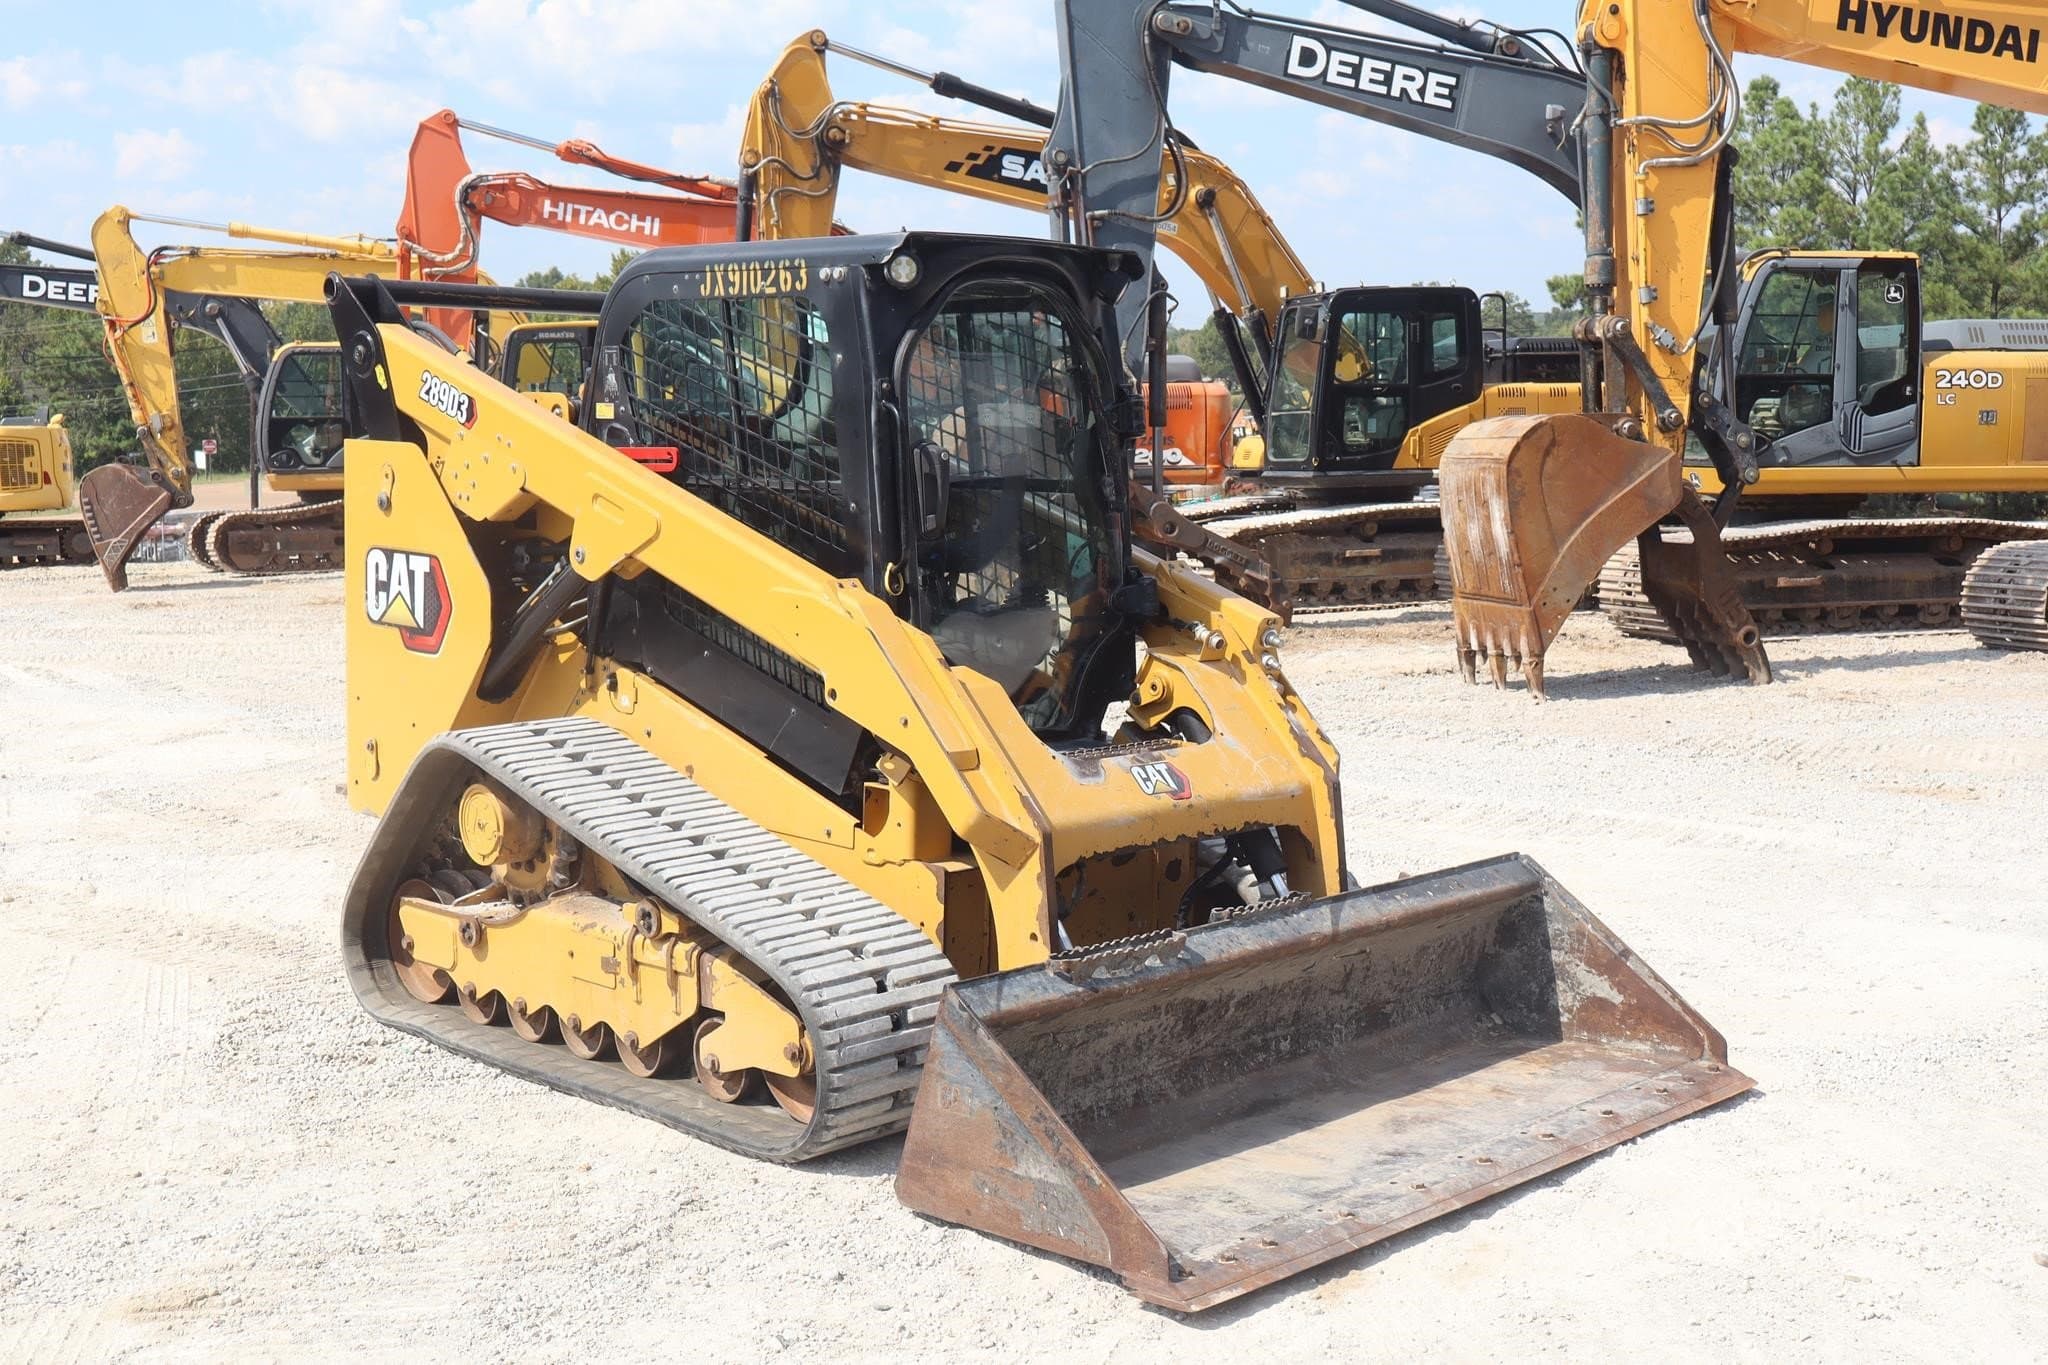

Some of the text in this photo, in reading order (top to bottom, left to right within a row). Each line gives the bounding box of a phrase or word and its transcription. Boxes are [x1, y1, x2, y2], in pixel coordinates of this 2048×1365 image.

[1836, 0, 2040, 63] HYUNDAI
[1287, 35, 1457, 109] DEERE
[543, 199, 660, 237] HITACHI
[700, 257, 808, 297] JX910263
[419, 370, 469, 424] 289D3
[1936, 369, 2004, 389] 240D
[1937, 393, 1956, 405] LC
[366, 548, 431, 630] CAT
[1130, 762, 1179, 795] CAT
